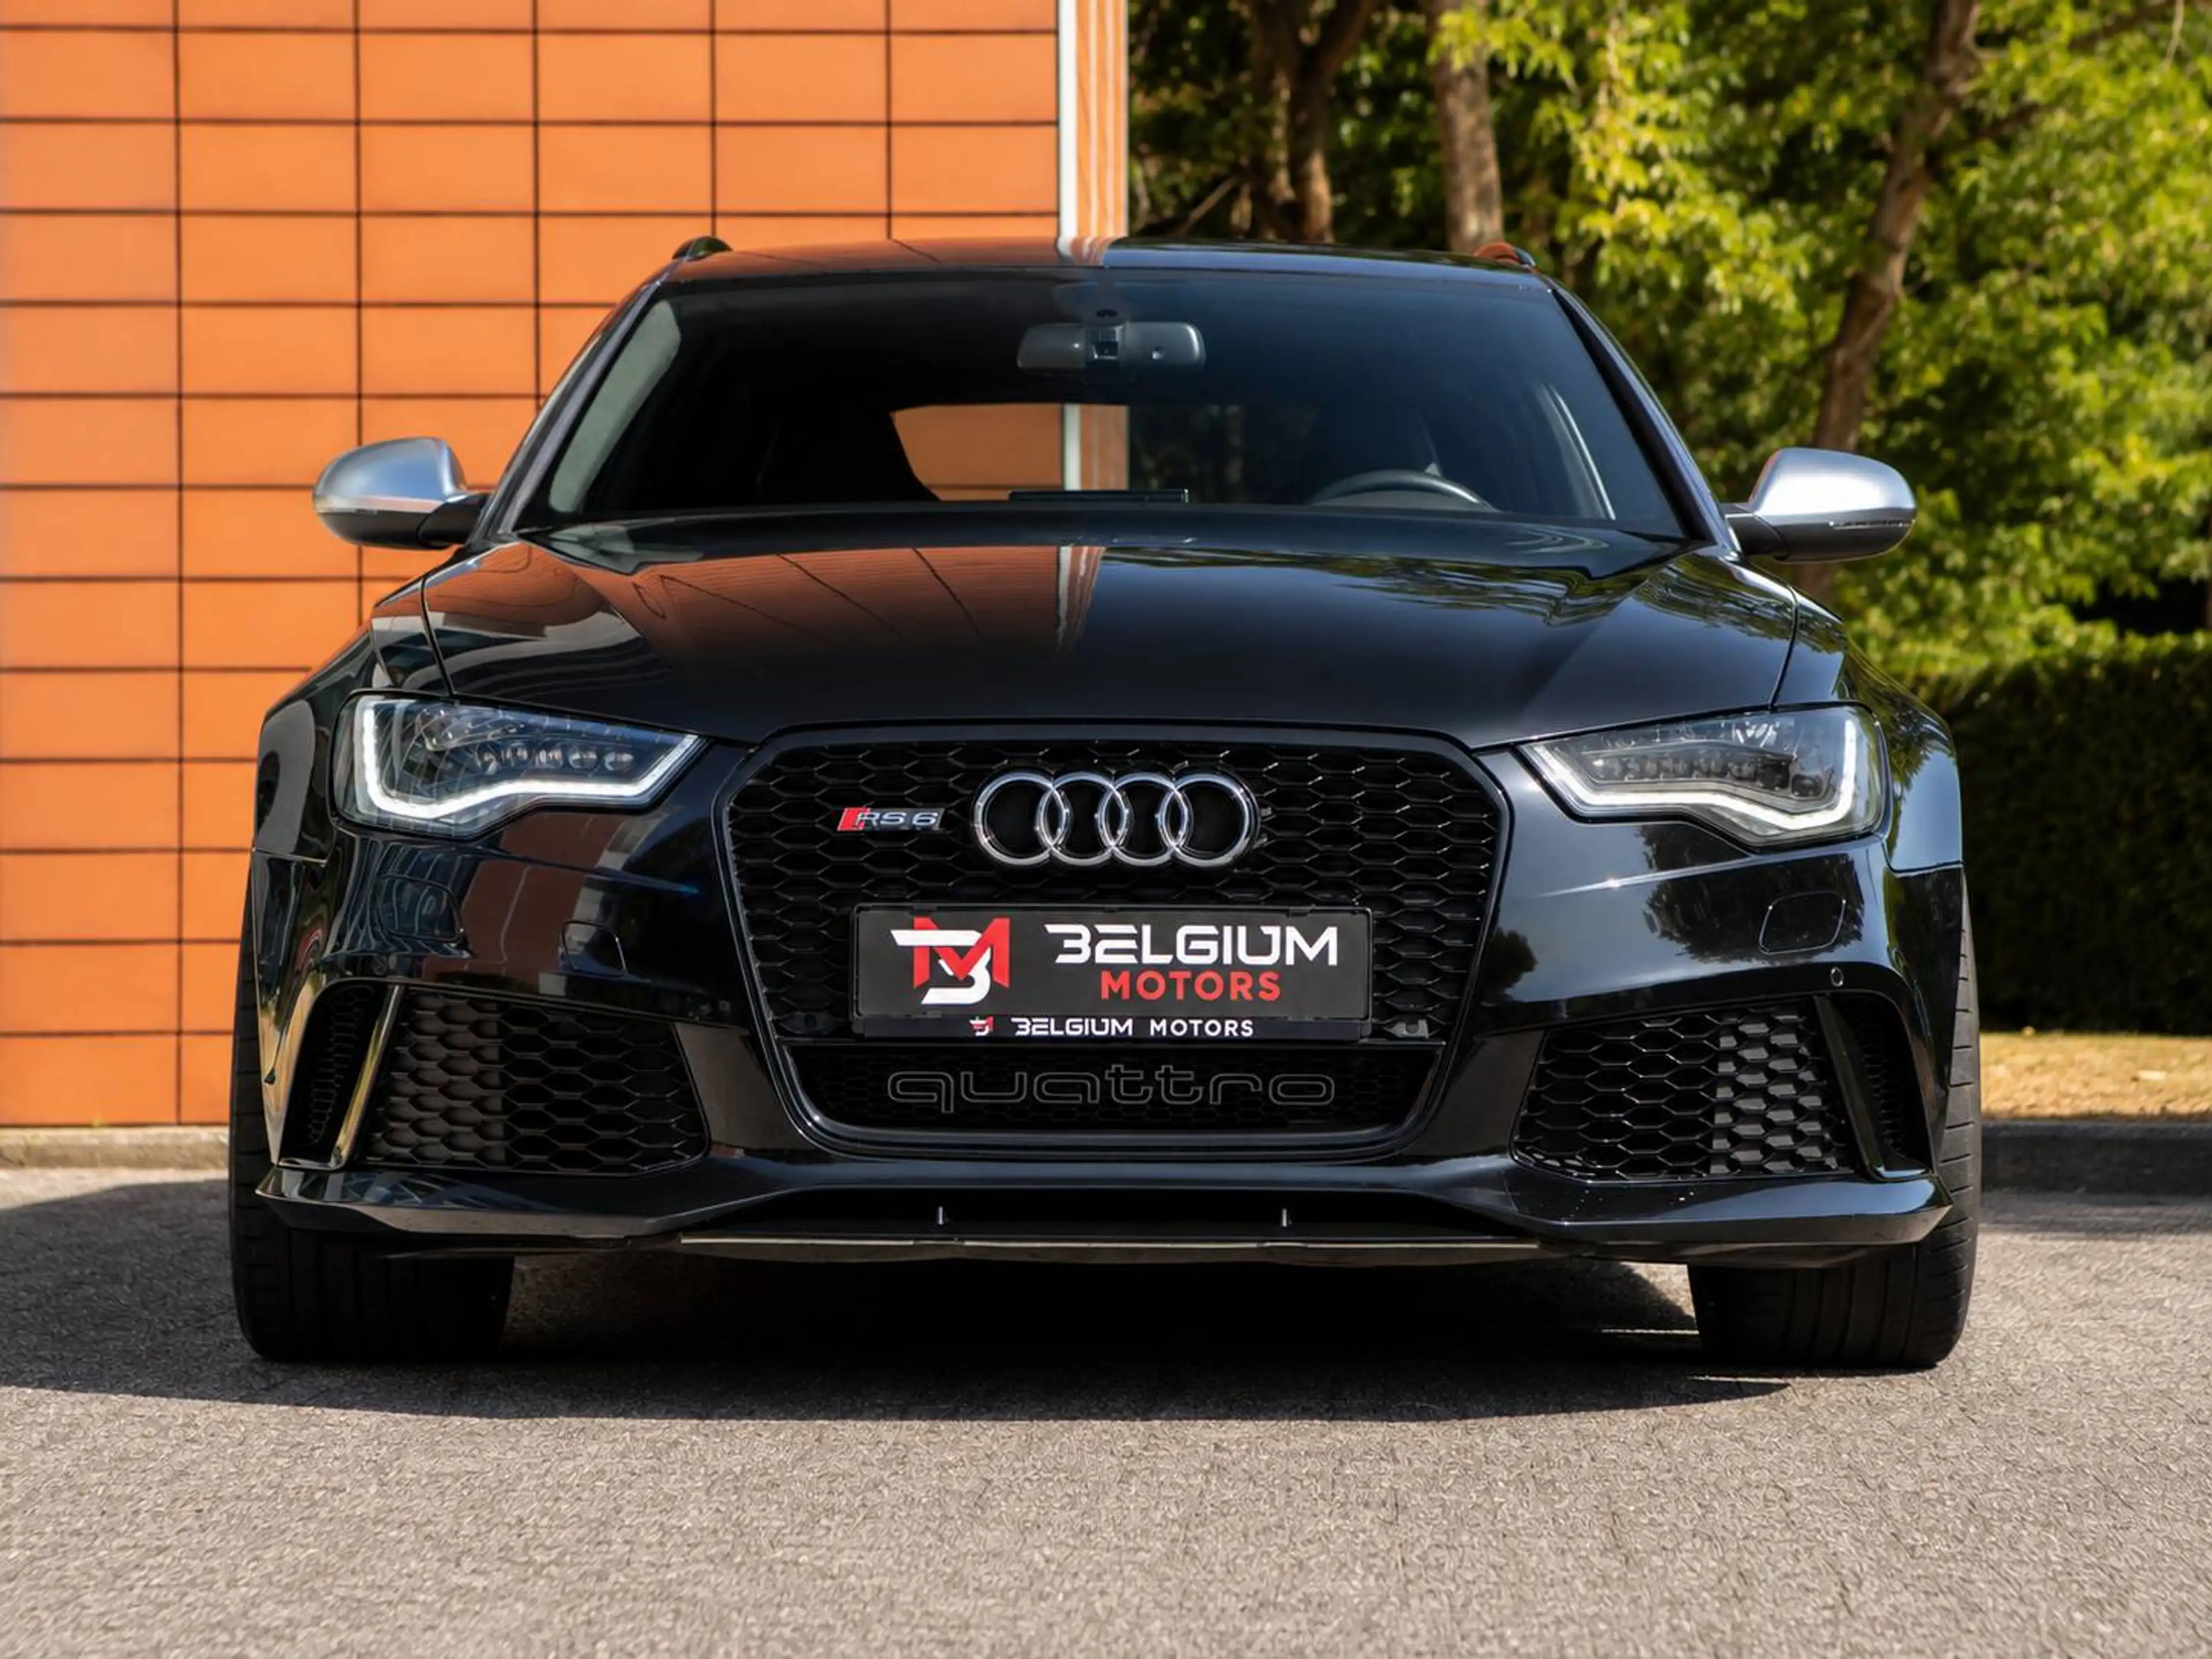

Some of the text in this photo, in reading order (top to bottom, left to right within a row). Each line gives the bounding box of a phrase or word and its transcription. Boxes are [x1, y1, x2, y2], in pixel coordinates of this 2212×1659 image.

[1045, 924, 1337, 966] BELGIUM
[1100, 970, 1281, 1001] MOTORS
[1011, 1018, 1133, 1036] BELGIUM
[1150, 1018, 1253, 1037] MOTORS
[888, 1065, 1334, 1113] quattro
